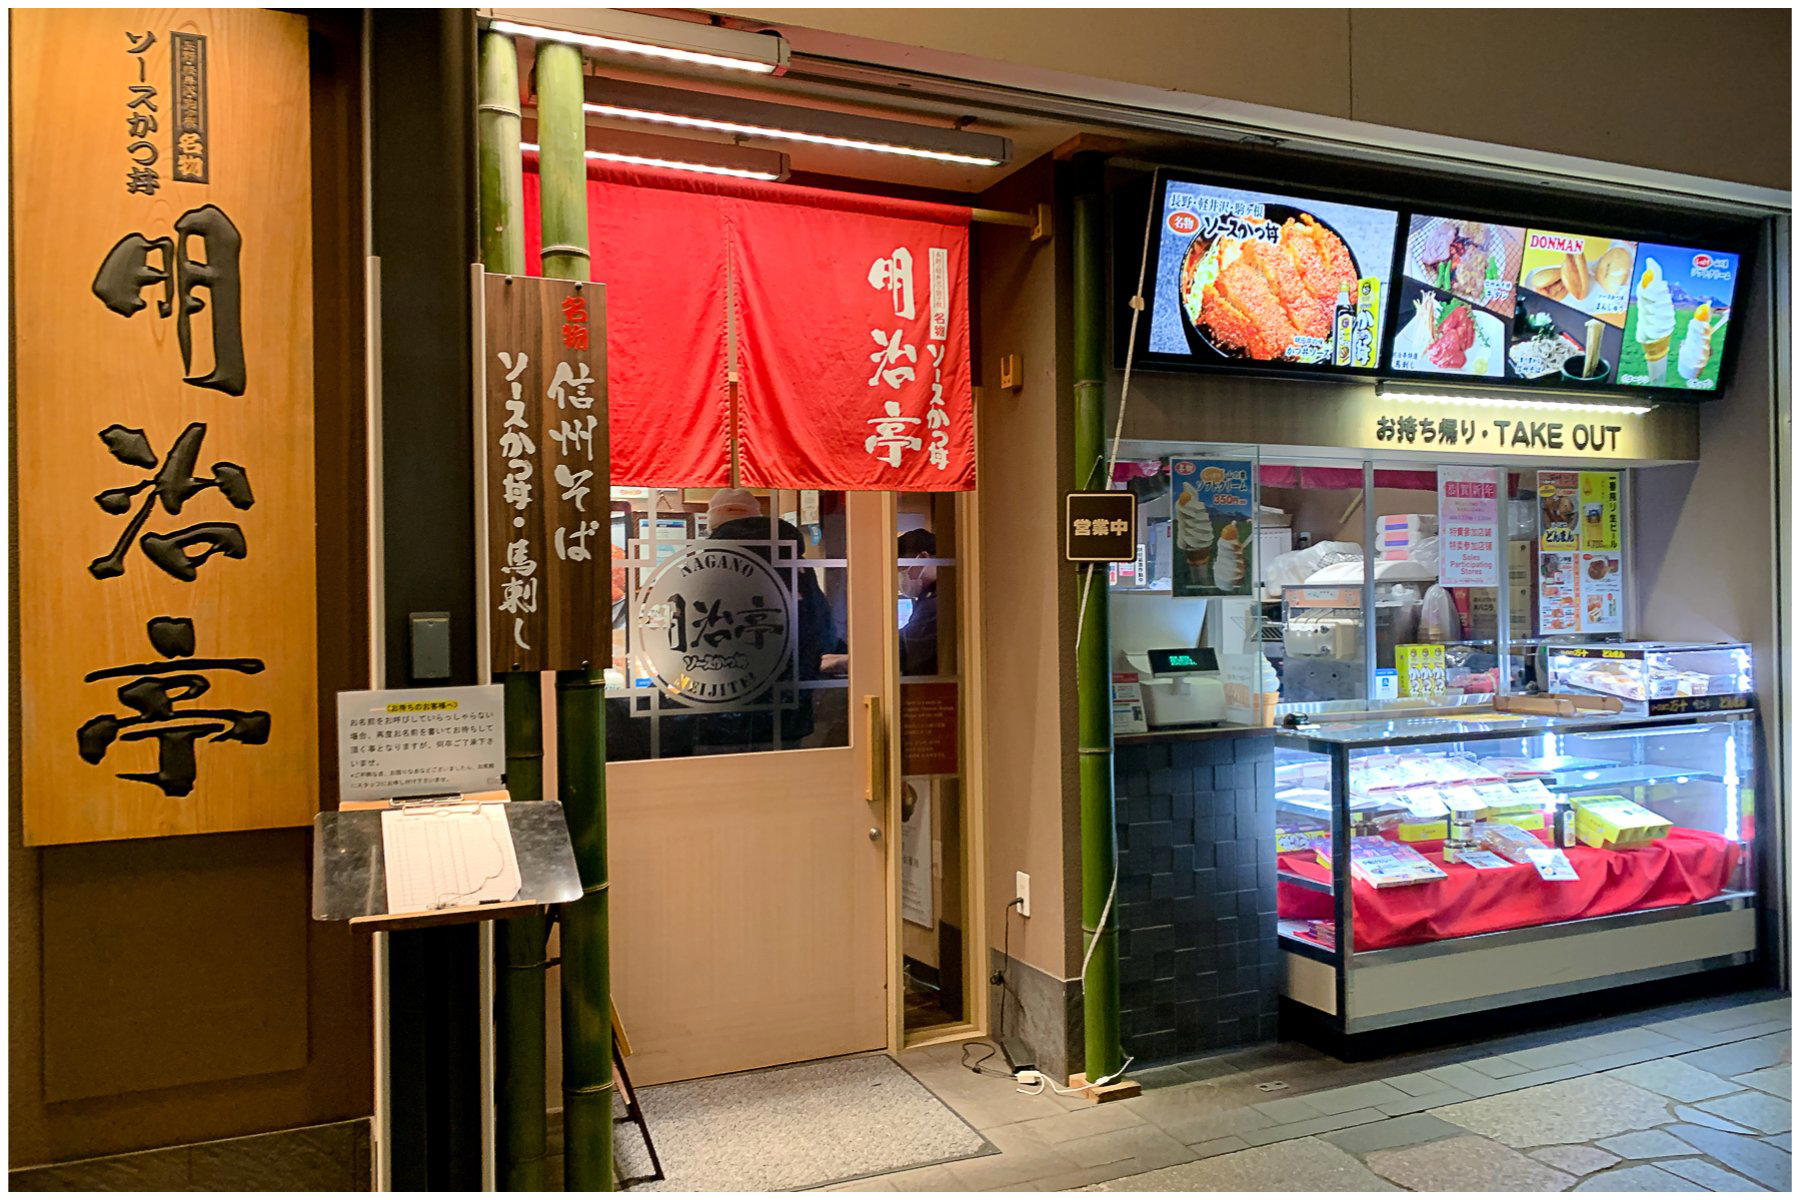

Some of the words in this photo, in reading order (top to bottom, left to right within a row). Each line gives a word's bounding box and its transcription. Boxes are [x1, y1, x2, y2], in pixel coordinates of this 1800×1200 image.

[126, 31, 160, 195] ソースかつ丼
[1174, 215, 1195, 230] 名物
[1204, 215, 1280, 244] ソースかつ丼
[1529, 234, 1584, 252] DONMAN
[561, 296, 590, 351] 名物
[865, 247, 922, 468] 明治亭
[927, 344, 950, 471] ソースかつ丼
[1493, 419, 1564, 449] TAKE
[1572, 423, 1622, 451] OUT
[547, 361, 600, 562] 信州そば
[77, 203, 271, 797] 明治亭
[1073, 518, 1129, 537] 営業中
[680, 554, 754, 578] NAGANO
